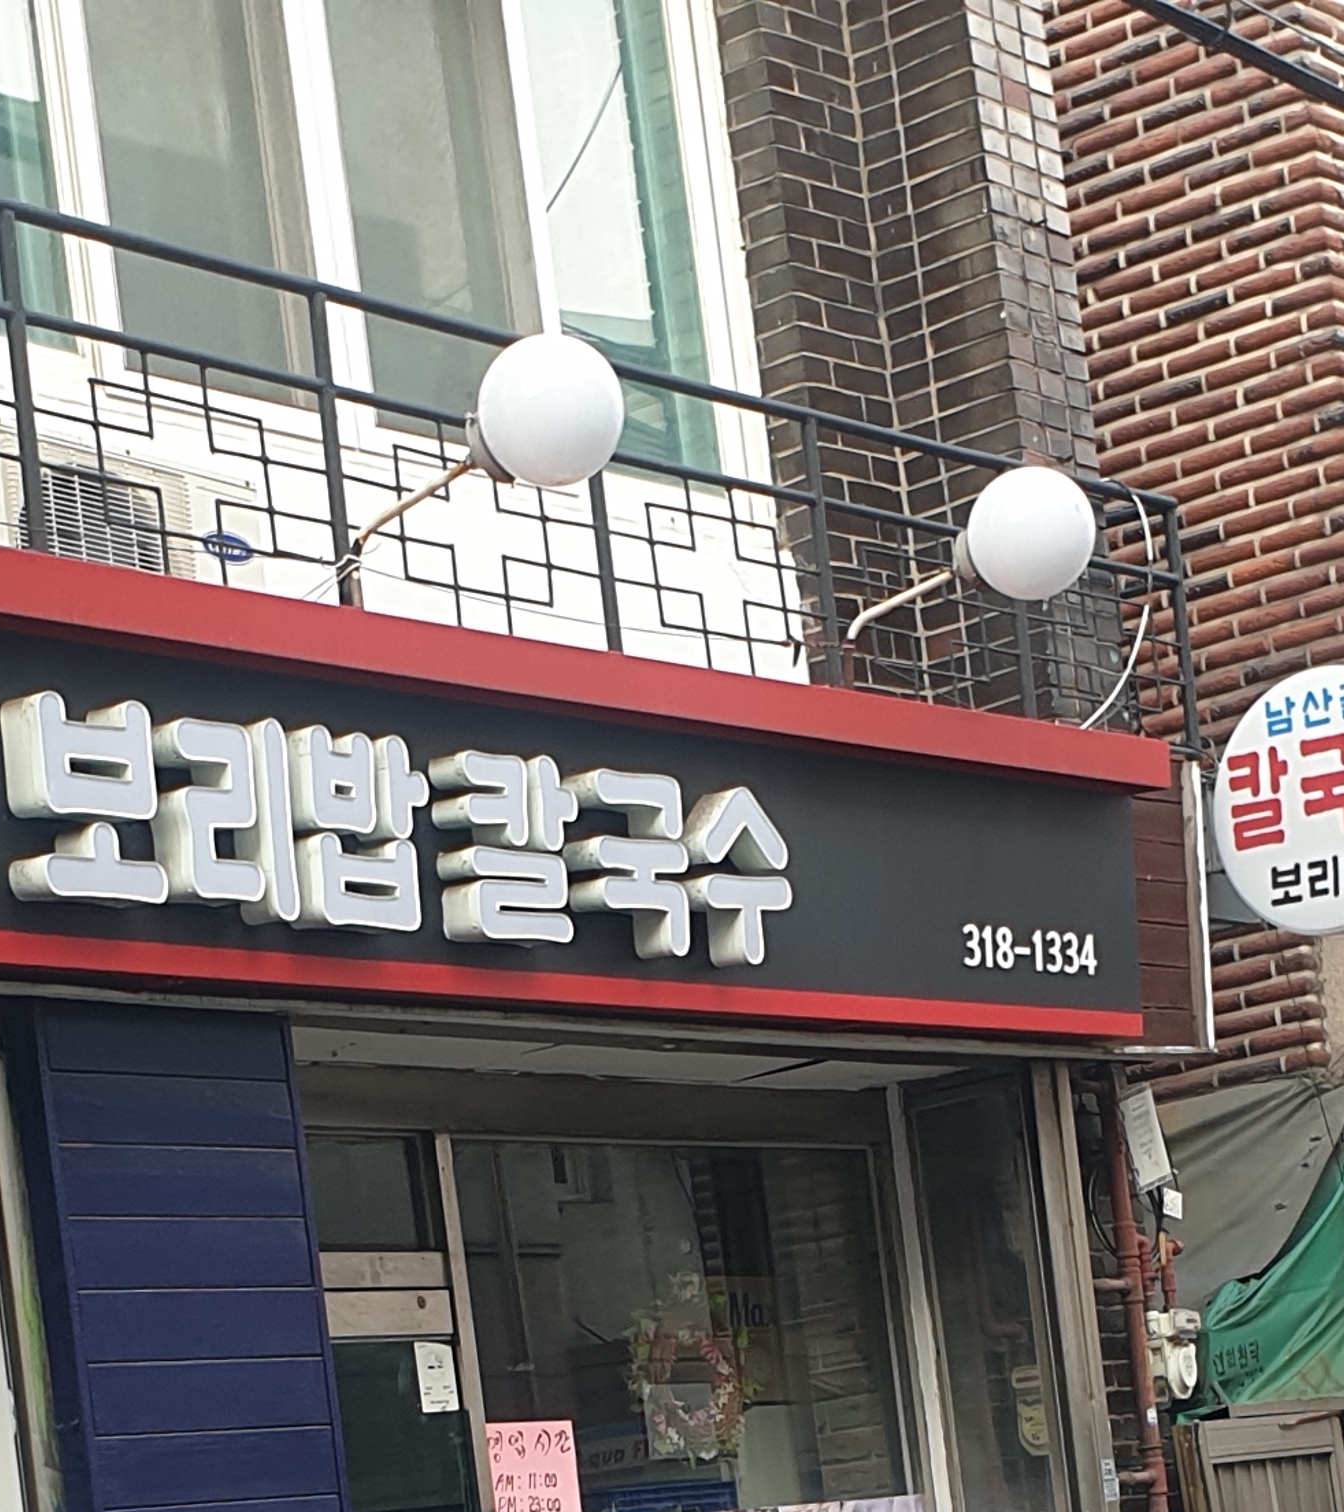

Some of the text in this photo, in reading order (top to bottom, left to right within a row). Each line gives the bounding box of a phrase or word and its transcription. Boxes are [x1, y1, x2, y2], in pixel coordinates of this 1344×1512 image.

[0, 688, 429, 934] 보리밥
[430, 749, 795, 968] 칼국수
[963, 922, 1098, 977] 318-1334
[528, 1472, 558, 1490] 11:00
